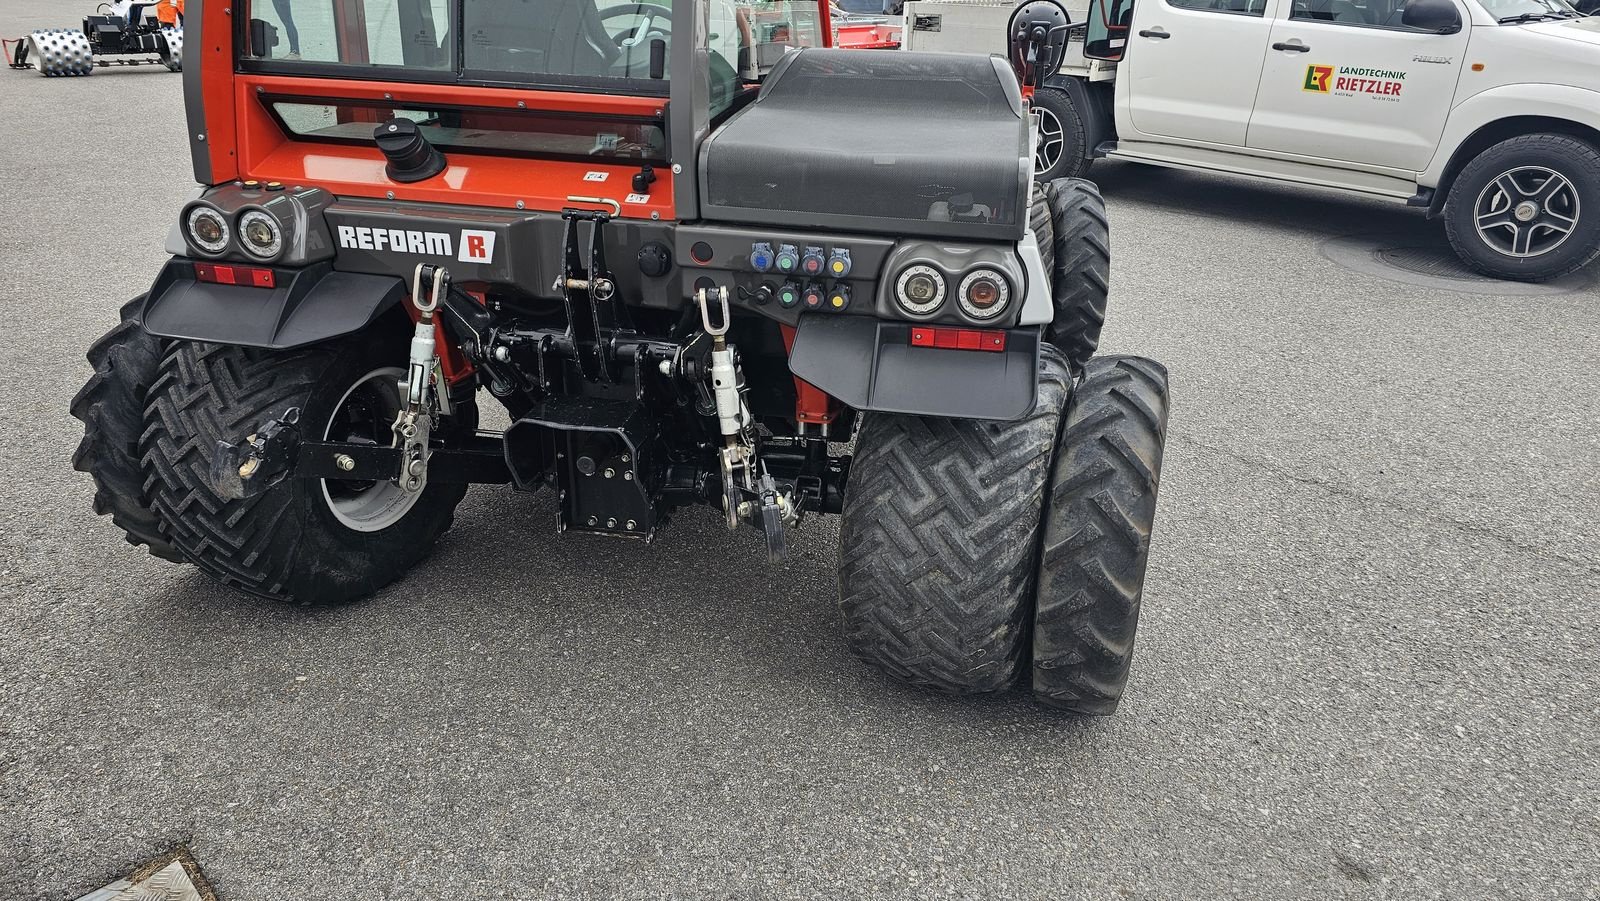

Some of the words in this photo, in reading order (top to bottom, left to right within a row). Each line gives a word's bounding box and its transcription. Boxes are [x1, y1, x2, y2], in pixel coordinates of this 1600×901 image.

[1339, 66, 1407, 80] LANDTECHNIK
[1335, 77, 1402, 96] RIETZLER
[337, 225, 453, 256] REFORM
[467, 235, 486, 258] R
